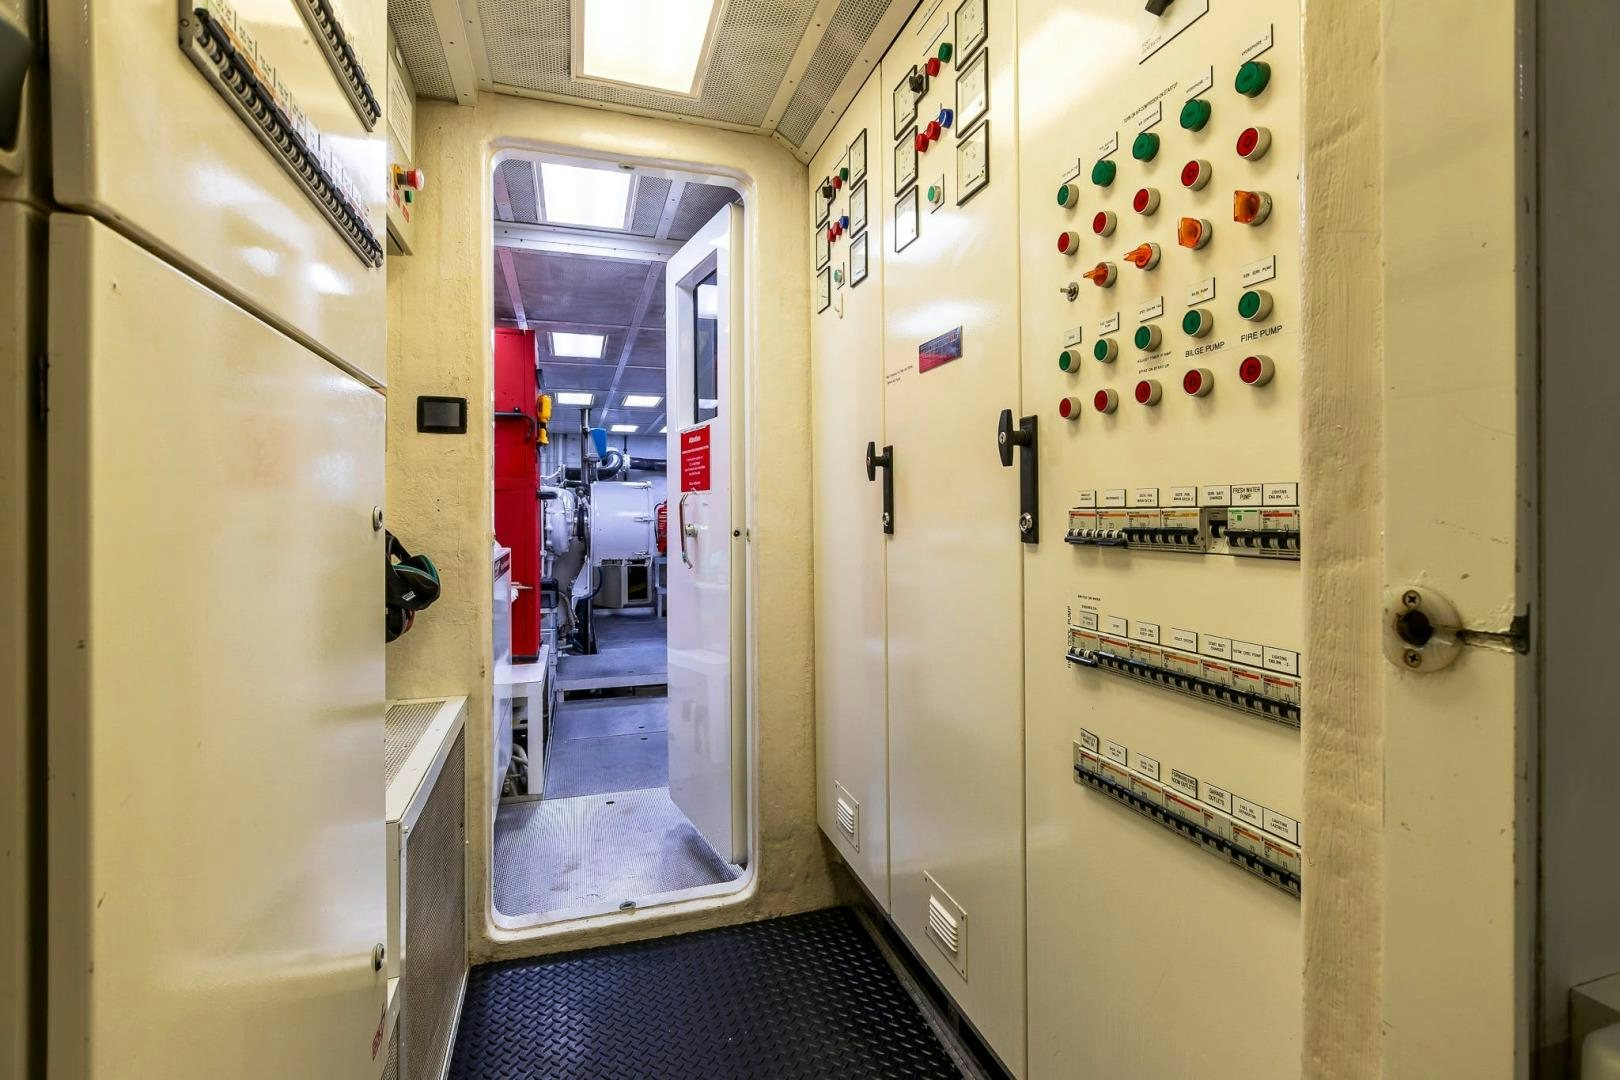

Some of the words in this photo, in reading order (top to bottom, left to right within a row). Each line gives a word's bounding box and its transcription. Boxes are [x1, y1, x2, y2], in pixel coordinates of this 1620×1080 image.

[1240, 331, 1258, 343] FIRE
[1260, 325, 1283, 338] PUMP
[1185, 346, 1204, 358] BILGE
[1205, 341, 1225, 353] PUMP
[1208, 788, 1224, 799] GARAGE
[1208, 794, 1225, 806] OUTLETS
